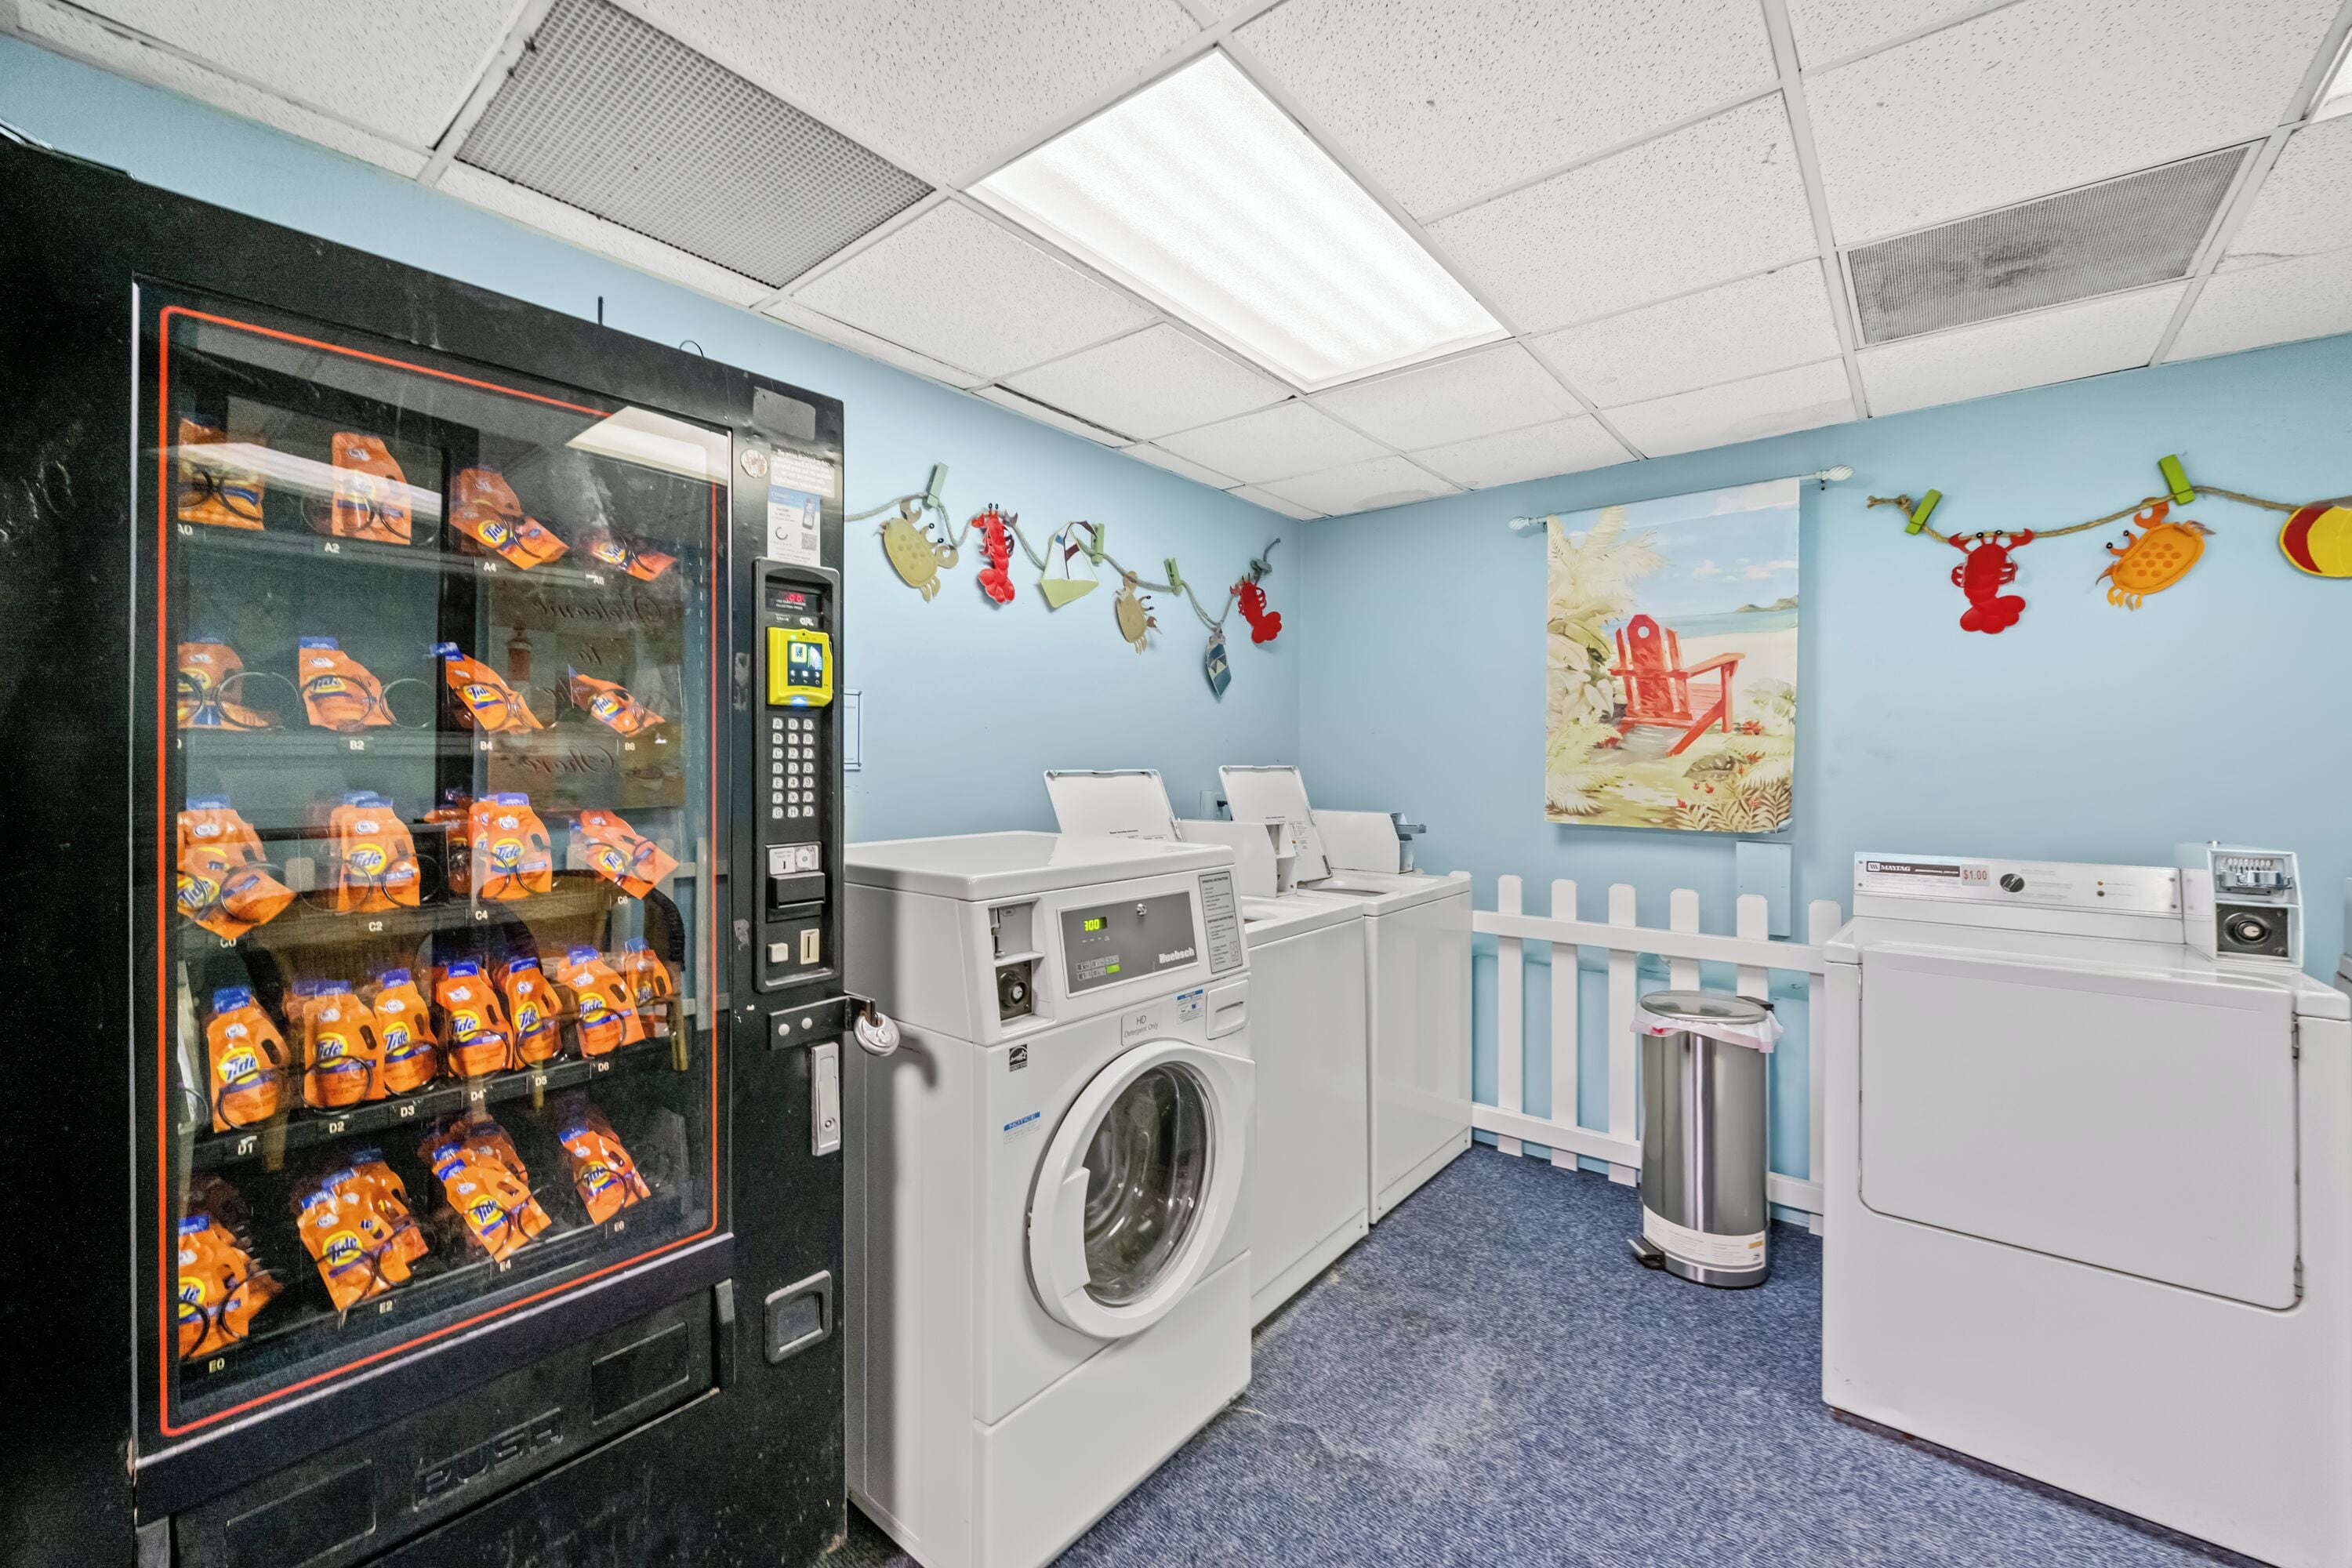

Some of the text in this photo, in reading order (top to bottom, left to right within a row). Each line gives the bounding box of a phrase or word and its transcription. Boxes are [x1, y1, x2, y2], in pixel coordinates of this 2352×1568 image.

[324, 542, 340, 554] A2
[483, 561, 497, 572] A4
[350, 739, 365, 750] B2
[480, 741, 493, 750] B4
[495, 844, 521, 861] Tide
[350, 851, 382, 867] Tide
[1963, 869, 1987, 880] $1.00
[475, 909, 488, 921] C4
[368, 921, 383, 933] C2
[1159, 947, 1195, 964] Huebsch
[1136, 1014, 1146, 1025] HD
[1124, 1022, 1159, 1038] Detergent Only
[385, 1030, 408, 1052] Tide
[597, 1062, 609, 1073] D6
[535, 1076, 547, 1087] D5
[470, 1090, 485, 1102] D4
[401, 1105, 415, 1118] D3
[328, 1121, 345, 1134] D2
[1009, 1114, 1036, 1129] NOTICE
[499, 1259, 511, 1272] E4
[209, 1357, 225, 1373] E0
